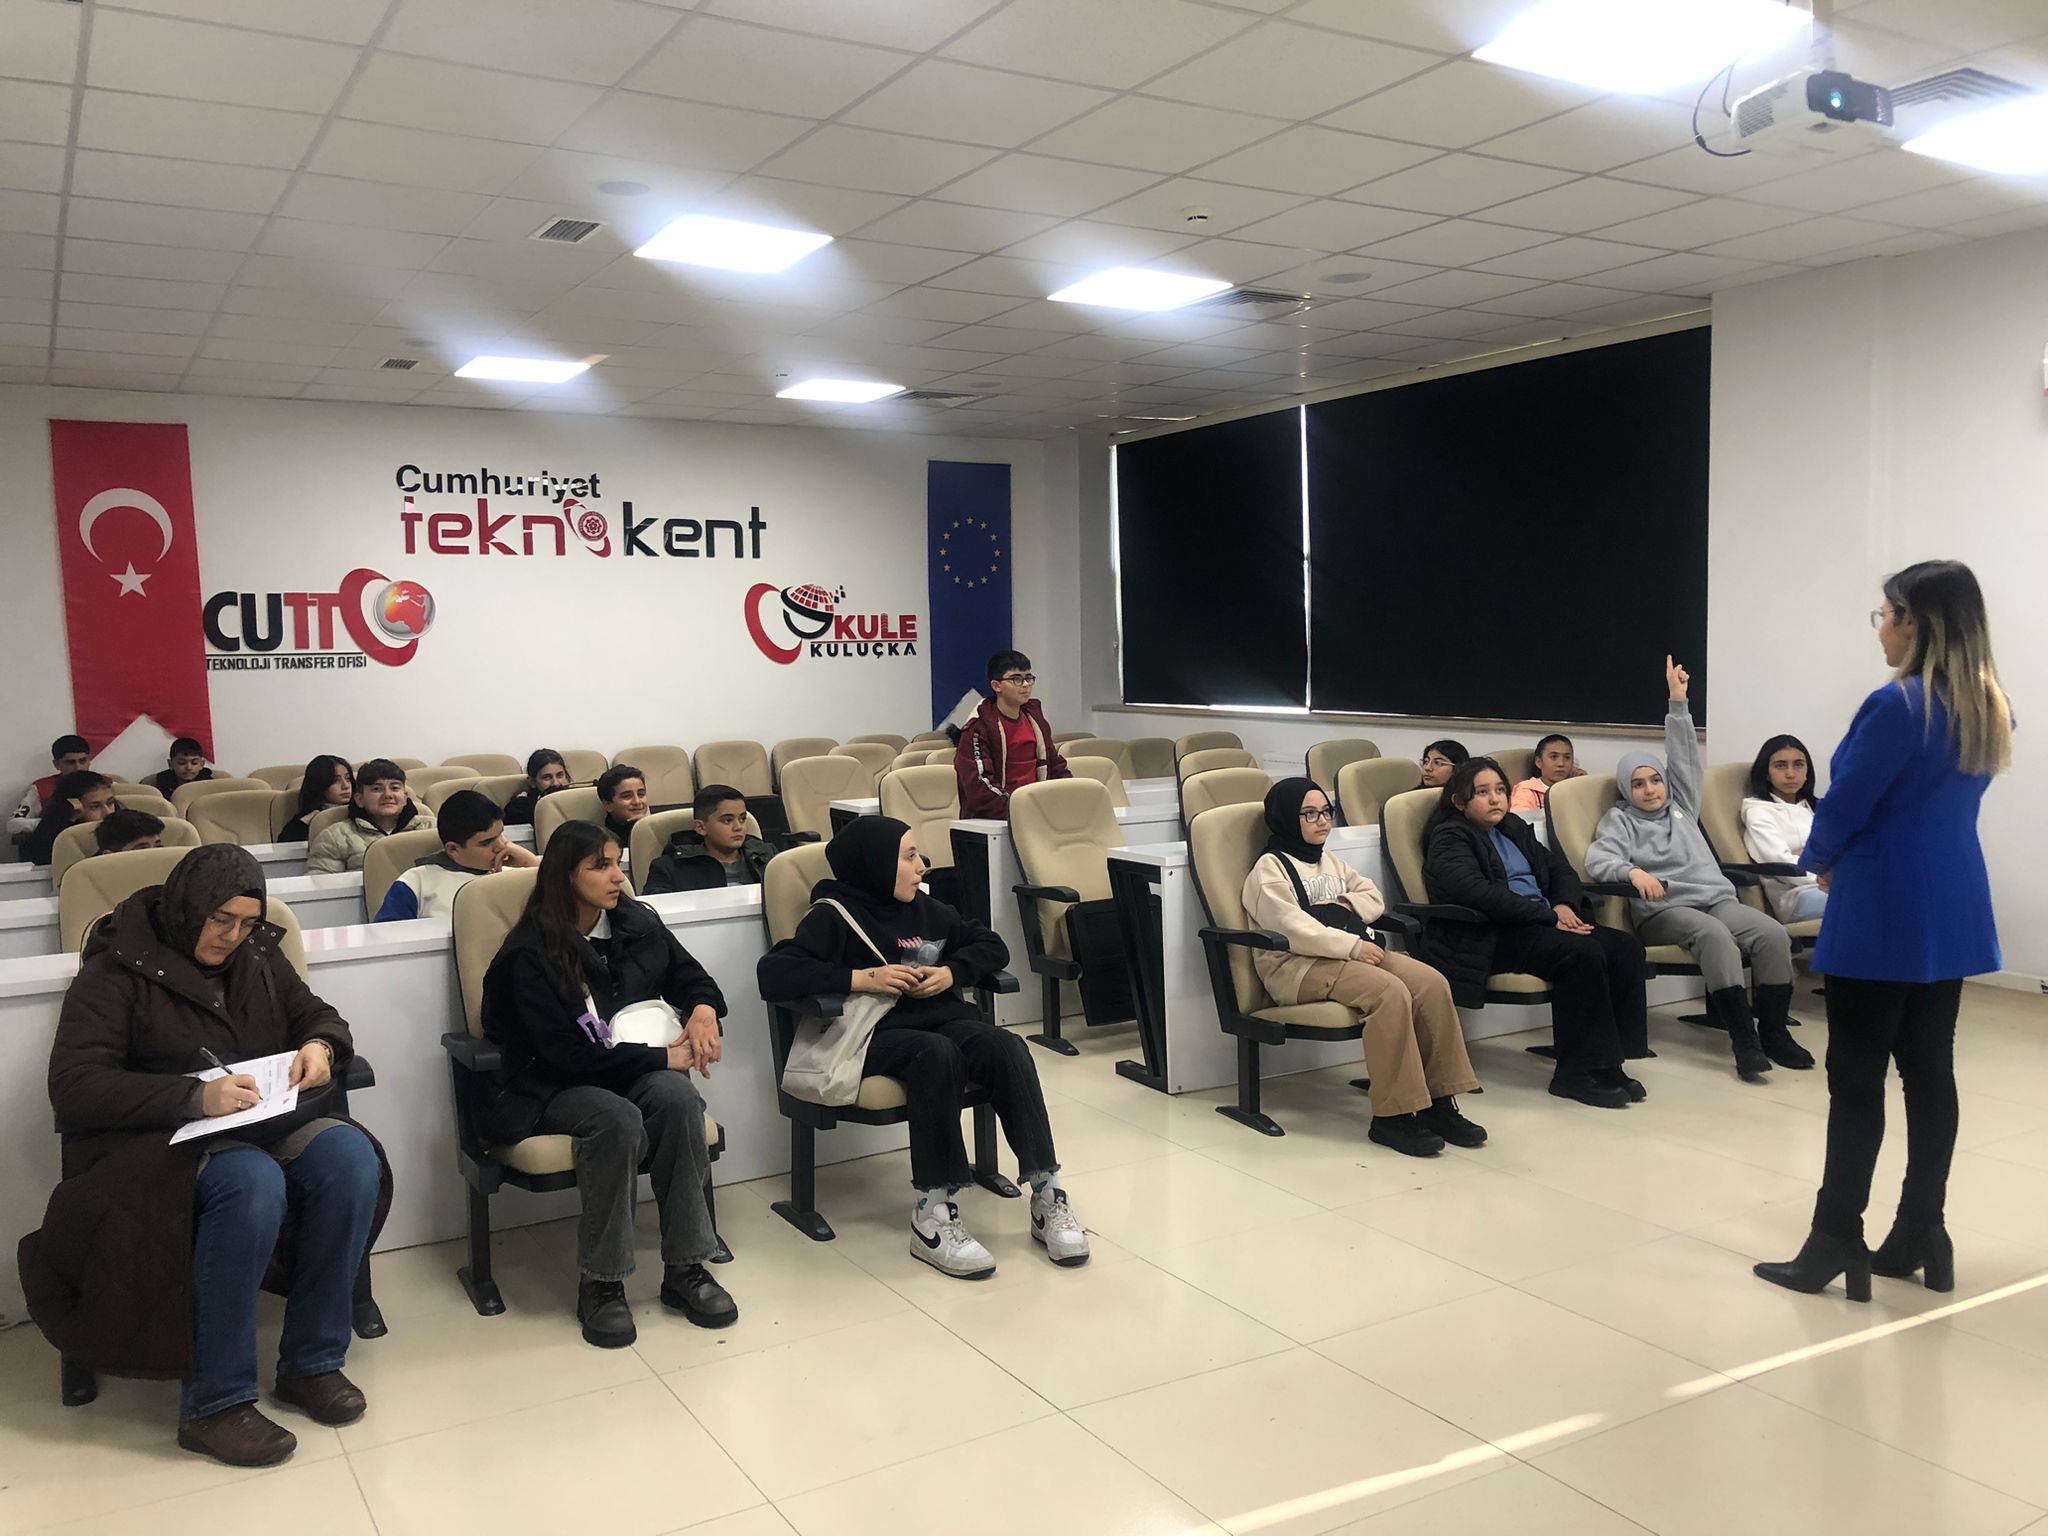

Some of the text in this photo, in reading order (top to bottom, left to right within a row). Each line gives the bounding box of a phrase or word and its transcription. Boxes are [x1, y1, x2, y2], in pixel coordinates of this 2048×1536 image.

[396, 464, 601, 503] Cumhuriyet
[810, 642, 918, 659] KULUÇKA
[274, 656, 336, 670] TRANSFER
